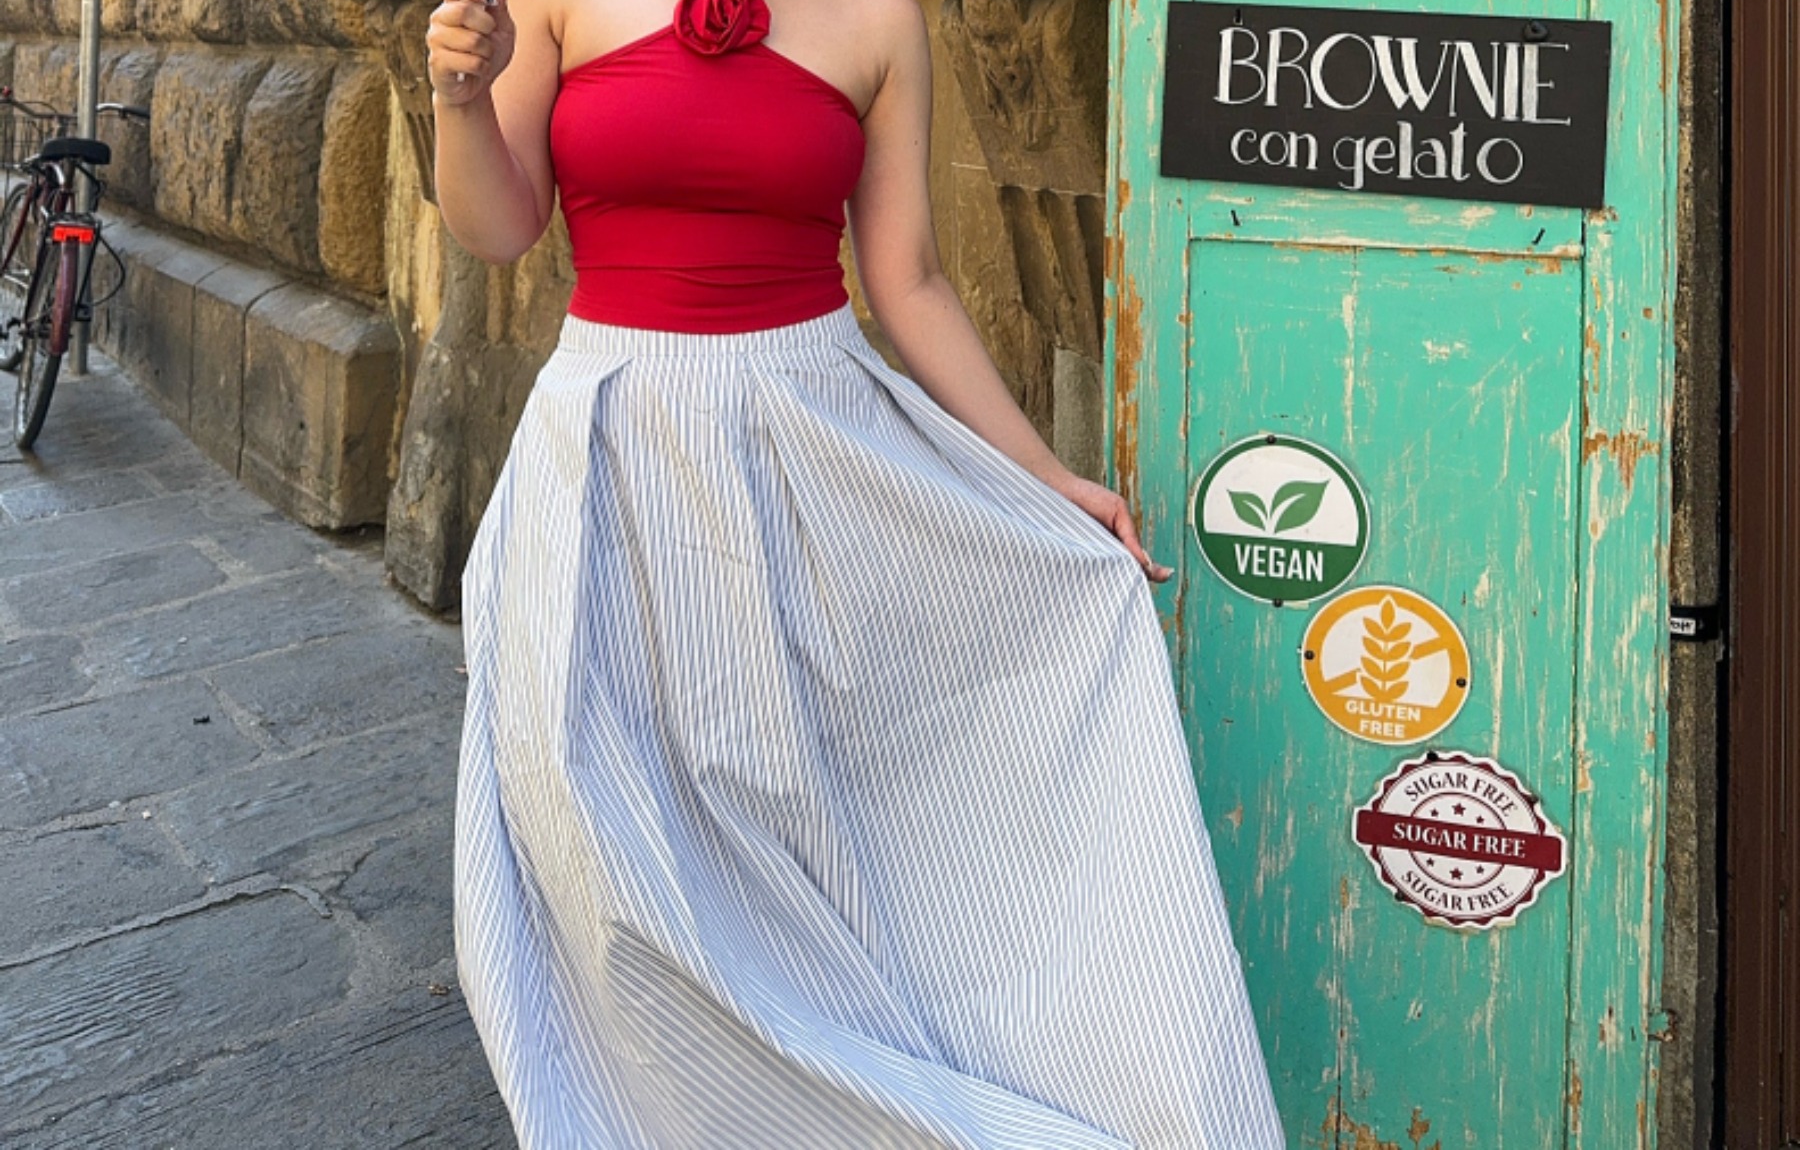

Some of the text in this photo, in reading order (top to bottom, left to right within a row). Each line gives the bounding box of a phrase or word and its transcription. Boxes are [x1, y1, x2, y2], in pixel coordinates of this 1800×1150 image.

[1213, 26, 1572, 126] BROWNIE
[1230, 121, 1524, 190] con gelato
[1234, 543, 1324, 582] VEGAN
[1345, 700, 1421, 722] GLUTEN
[1359, 718, 1405, 738] FREE
[1404, 772, 1517, 818] SUGAR FREE
[1392, 822, 1526, 858] SUGAR FREE
[1401, 870, 1514, 912] SUGAR FREE
